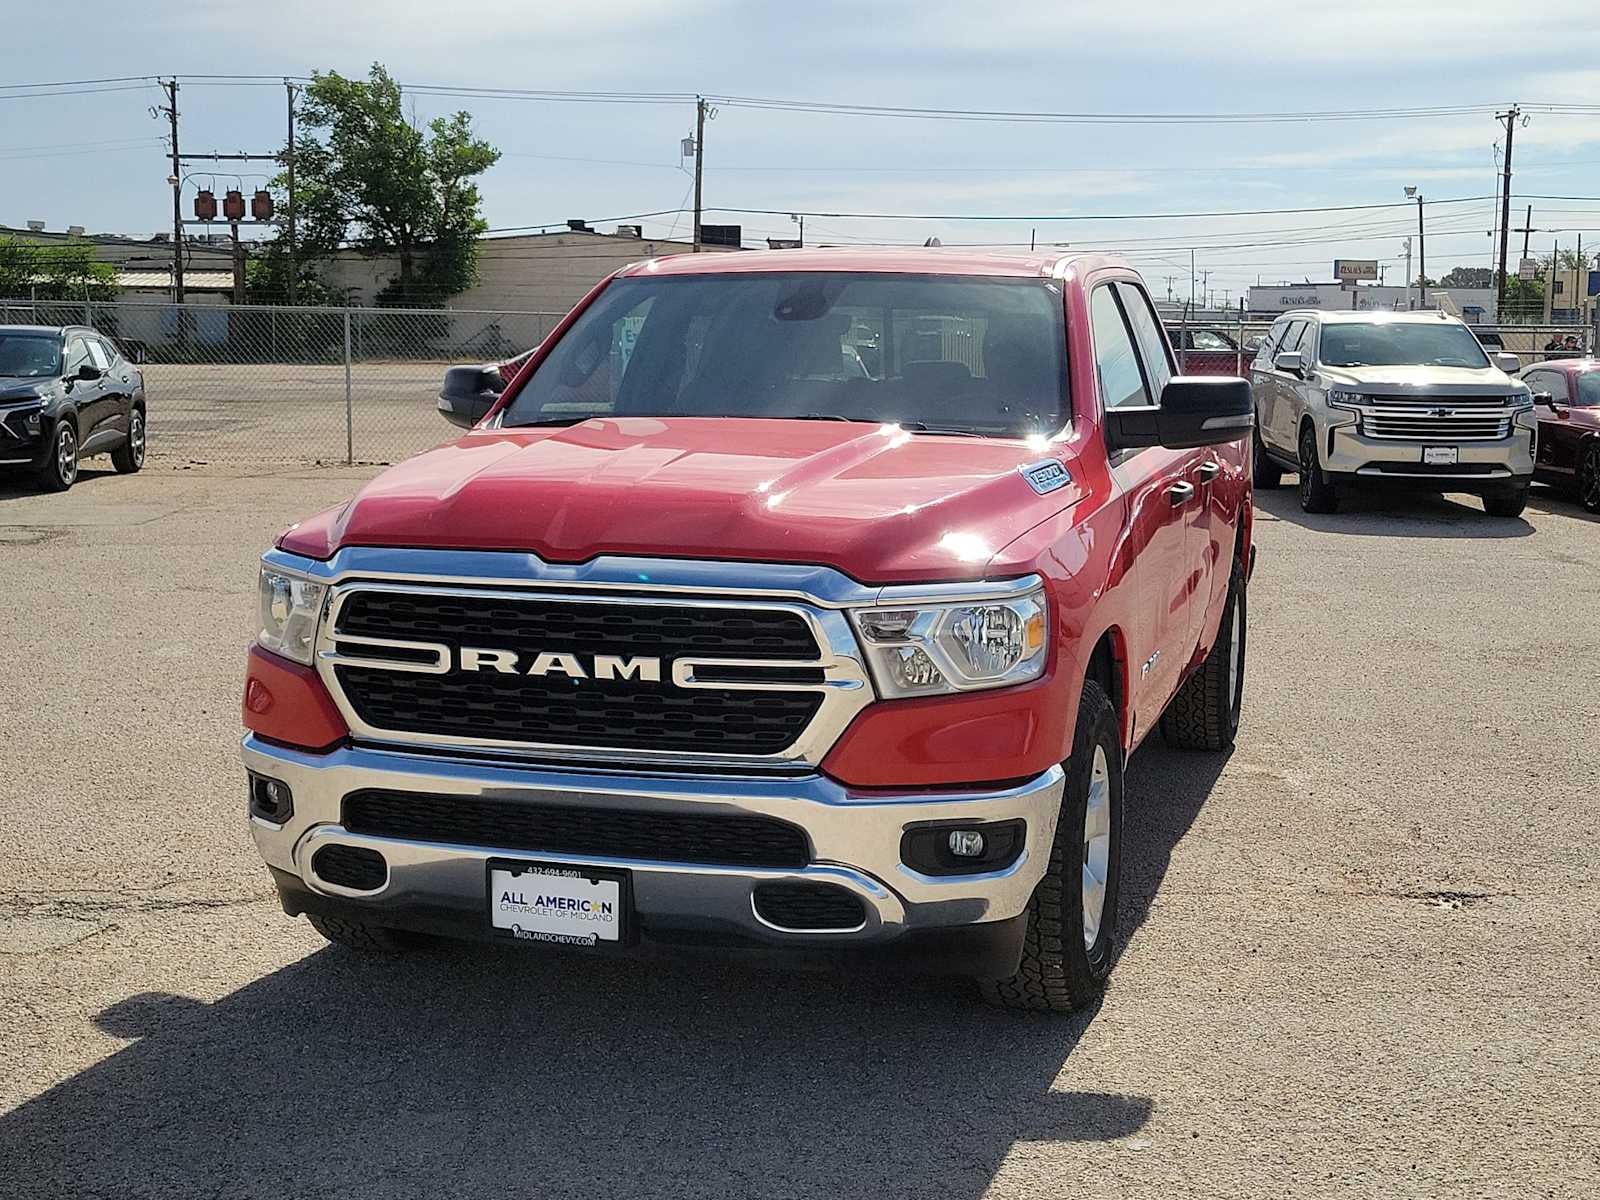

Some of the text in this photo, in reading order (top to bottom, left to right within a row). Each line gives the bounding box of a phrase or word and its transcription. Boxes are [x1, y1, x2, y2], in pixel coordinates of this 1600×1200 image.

[1030, 464, 1061, 485] 1500
[460, 646, 661, 682] RAM
[528, 867, 582, 878] 432-694-9601
[500, 891, 612, 914] ALL AMERICN
[500, 904, 613, 922] CHEVROLET OF MIDLAND
[514, 930, 596, 946] MIDLANDCHEVY.COM
